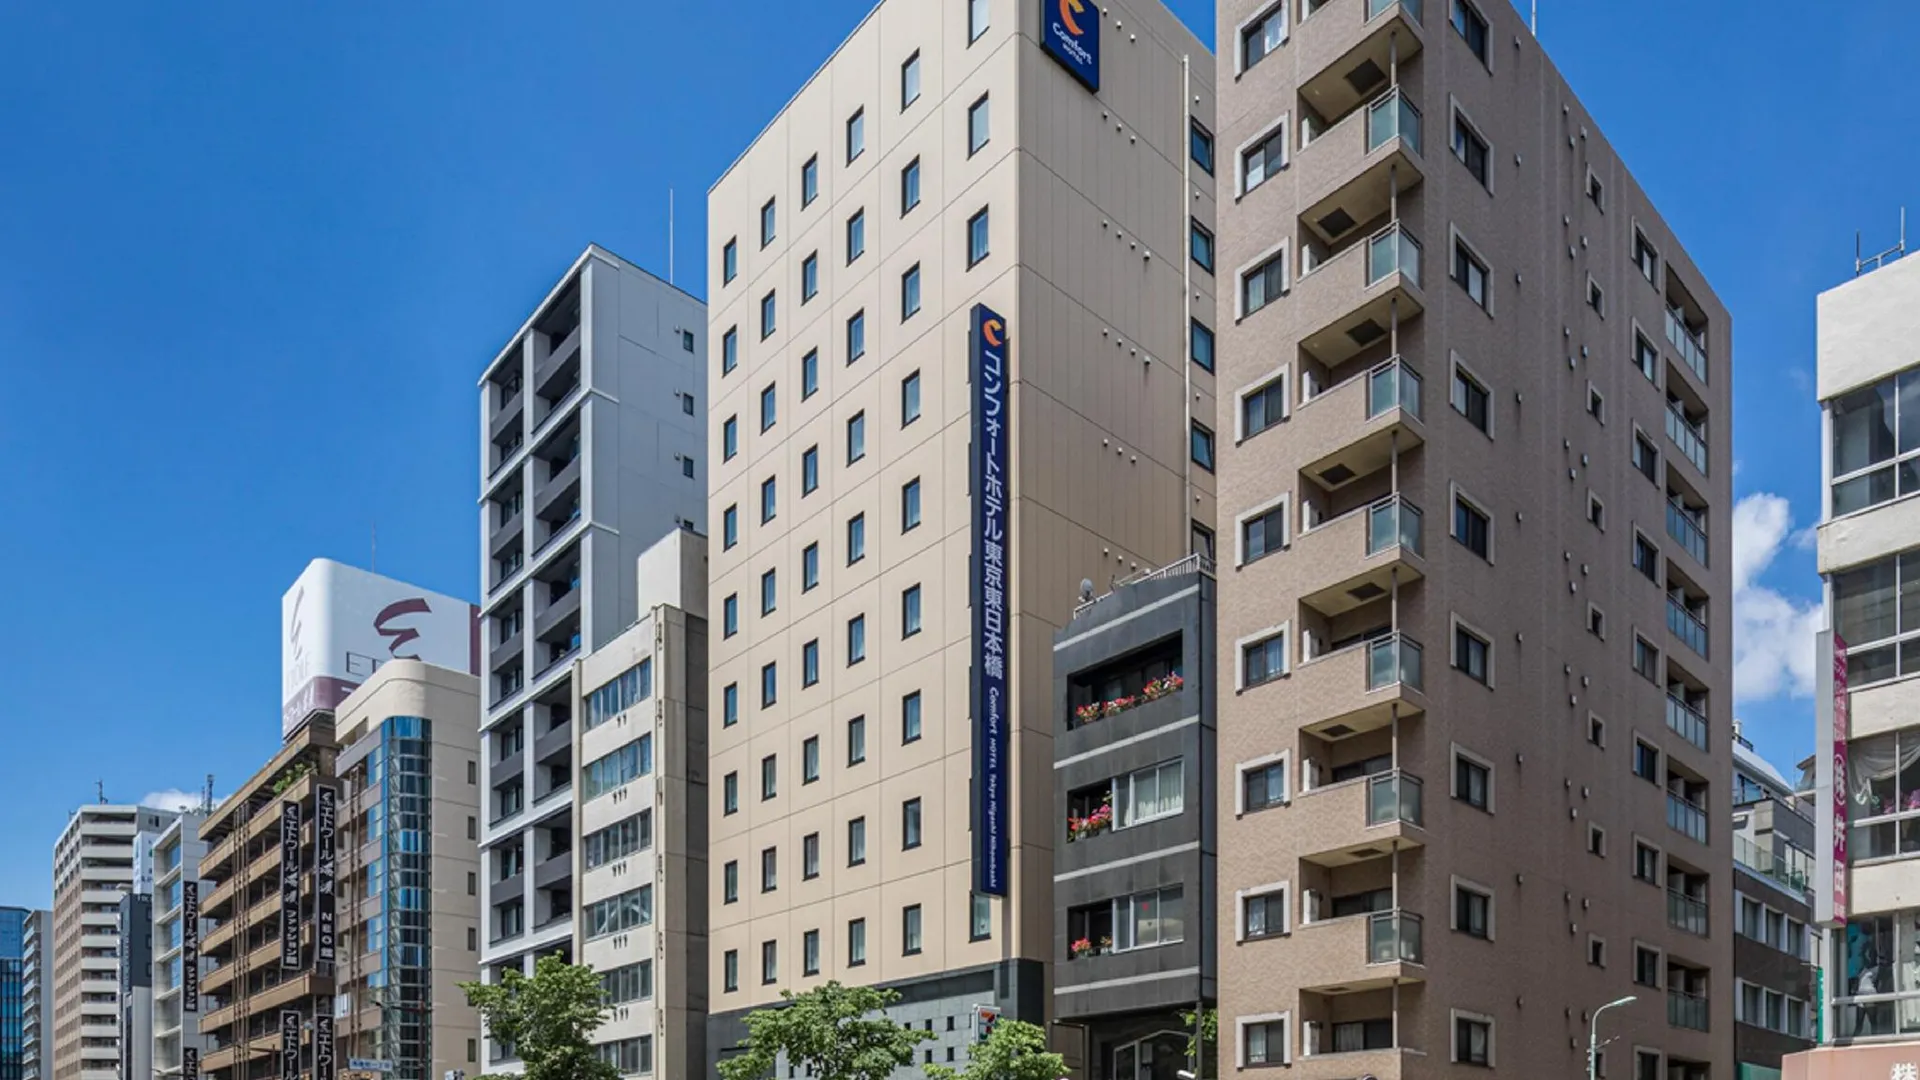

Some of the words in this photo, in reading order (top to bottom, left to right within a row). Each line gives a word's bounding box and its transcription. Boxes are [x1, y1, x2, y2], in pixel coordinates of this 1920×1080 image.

[1052, 22, 1093, 65] Comfort
[984, 349, 1004, 680] コンフォートホテル東京東日本橋
[988, 686, 1001, 735] Comfort
[989, 736, 998, 769] HOTEL
